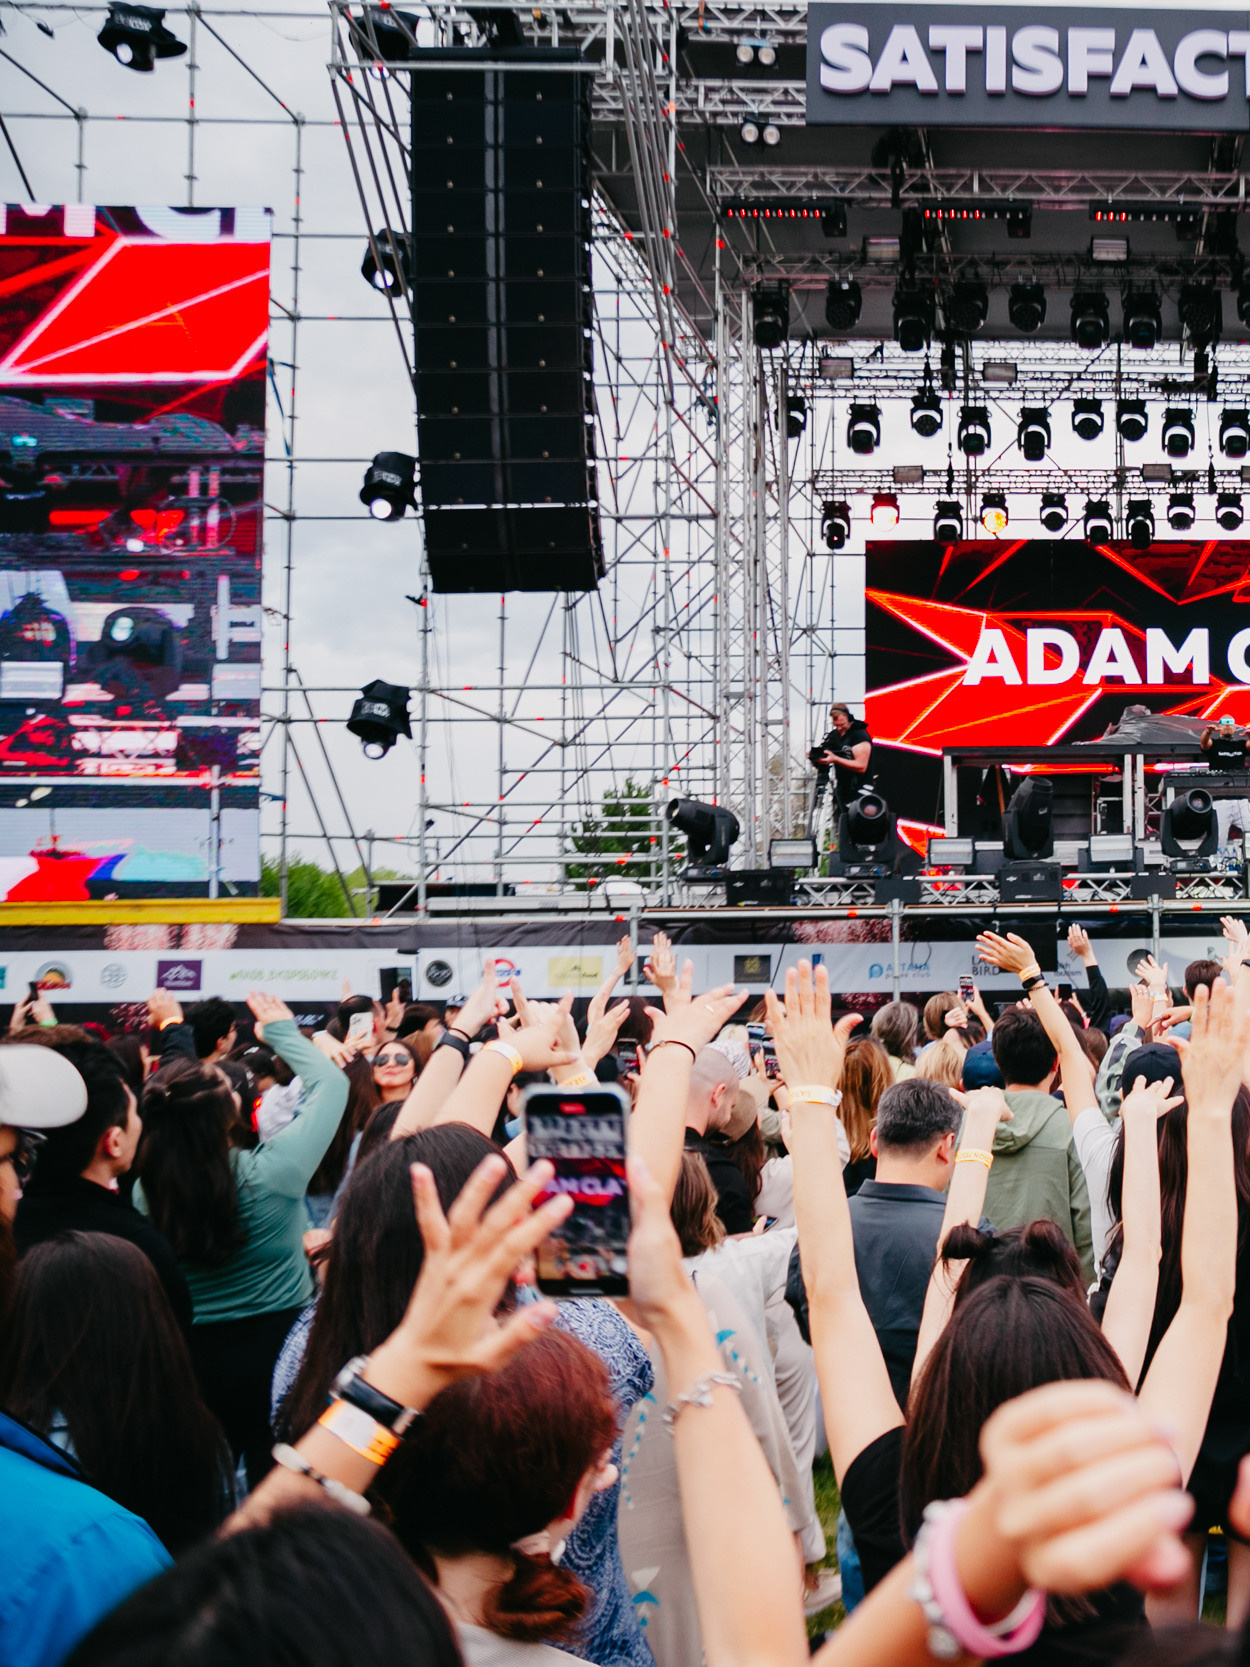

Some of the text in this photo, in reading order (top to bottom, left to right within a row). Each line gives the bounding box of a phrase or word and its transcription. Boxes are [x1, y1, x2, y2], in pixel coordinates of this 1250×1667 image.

[962, 627, 1210, 685] ADAM
[885, 962, 931, 972] ATANA
[971, 965, 1000, 977] BIRD
